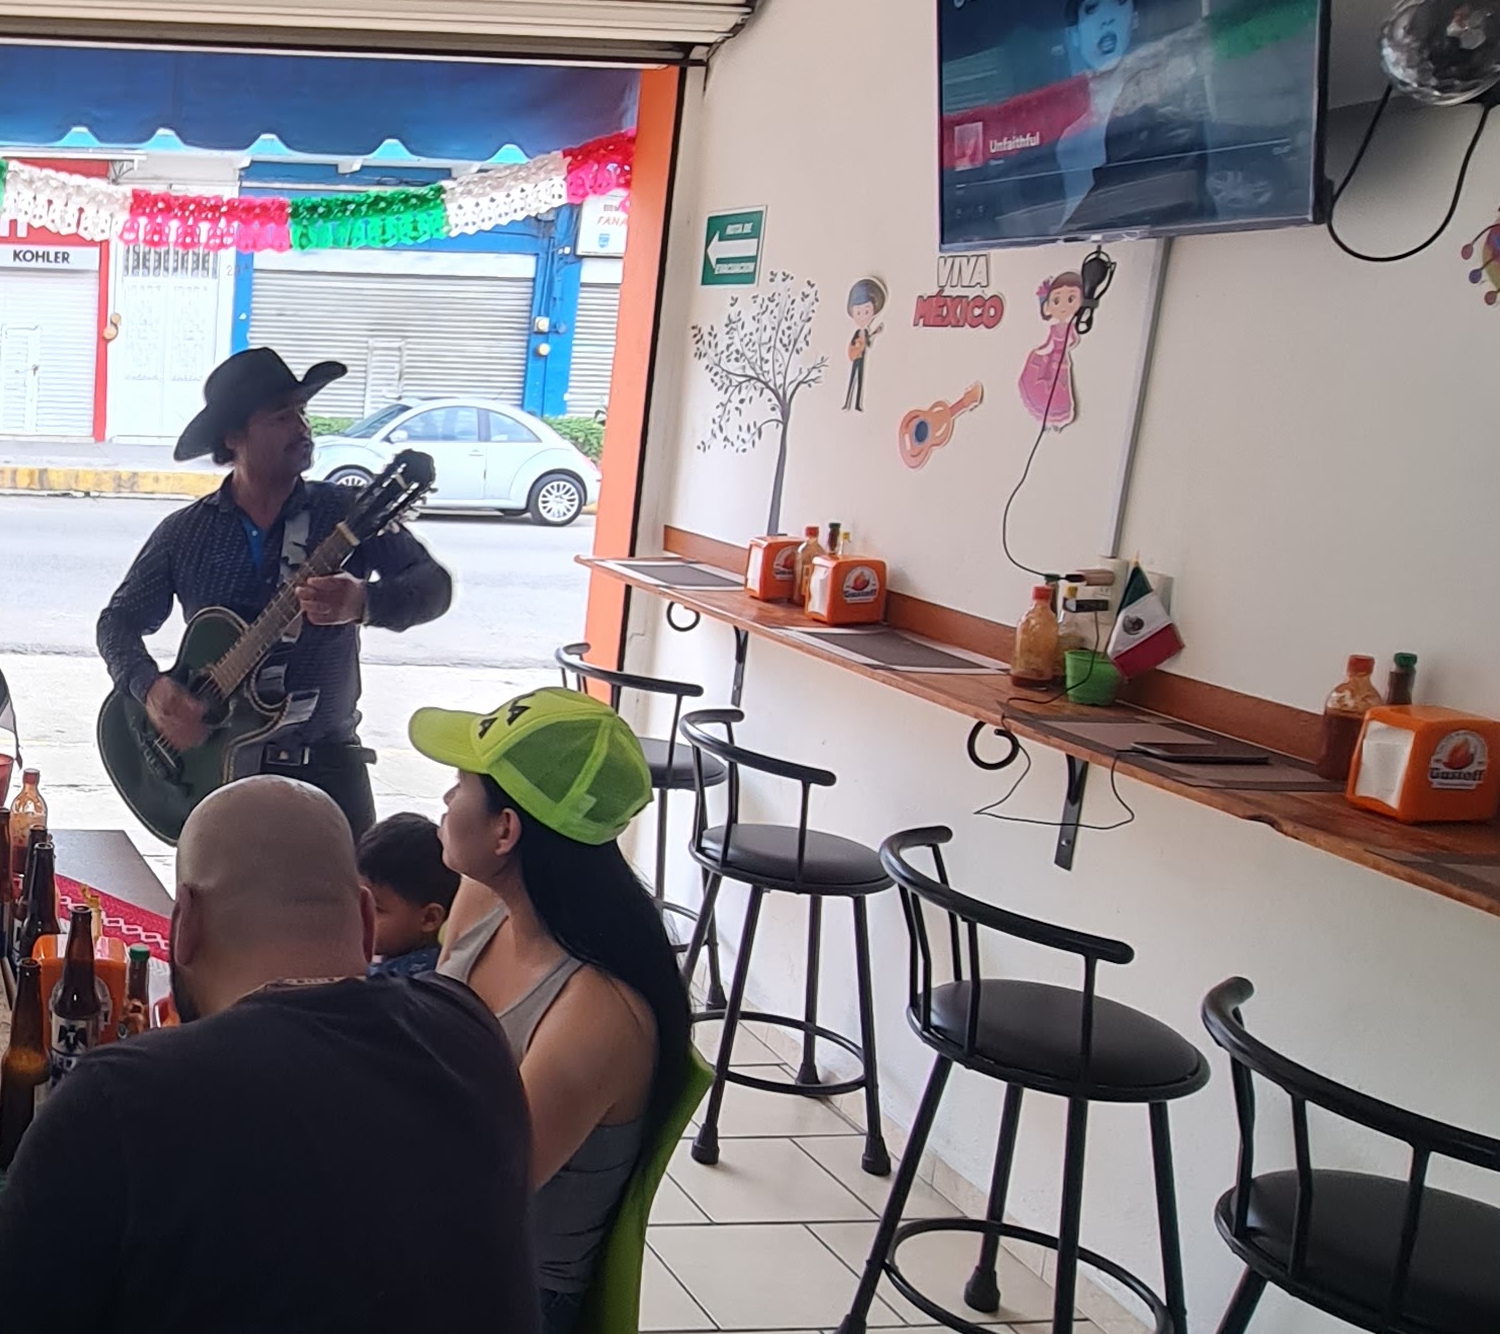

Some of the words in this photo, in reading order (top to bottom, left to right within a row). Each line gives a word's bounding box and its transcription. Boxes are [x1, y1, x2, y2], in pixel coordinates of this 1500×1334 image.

[989, 131, 1040, 153] Unfaithful
[12, 249, 70, 264] KOHLER
[937, 254, 989, 288] VIVA
[913, 288, 1004, 329] MÉXICO
